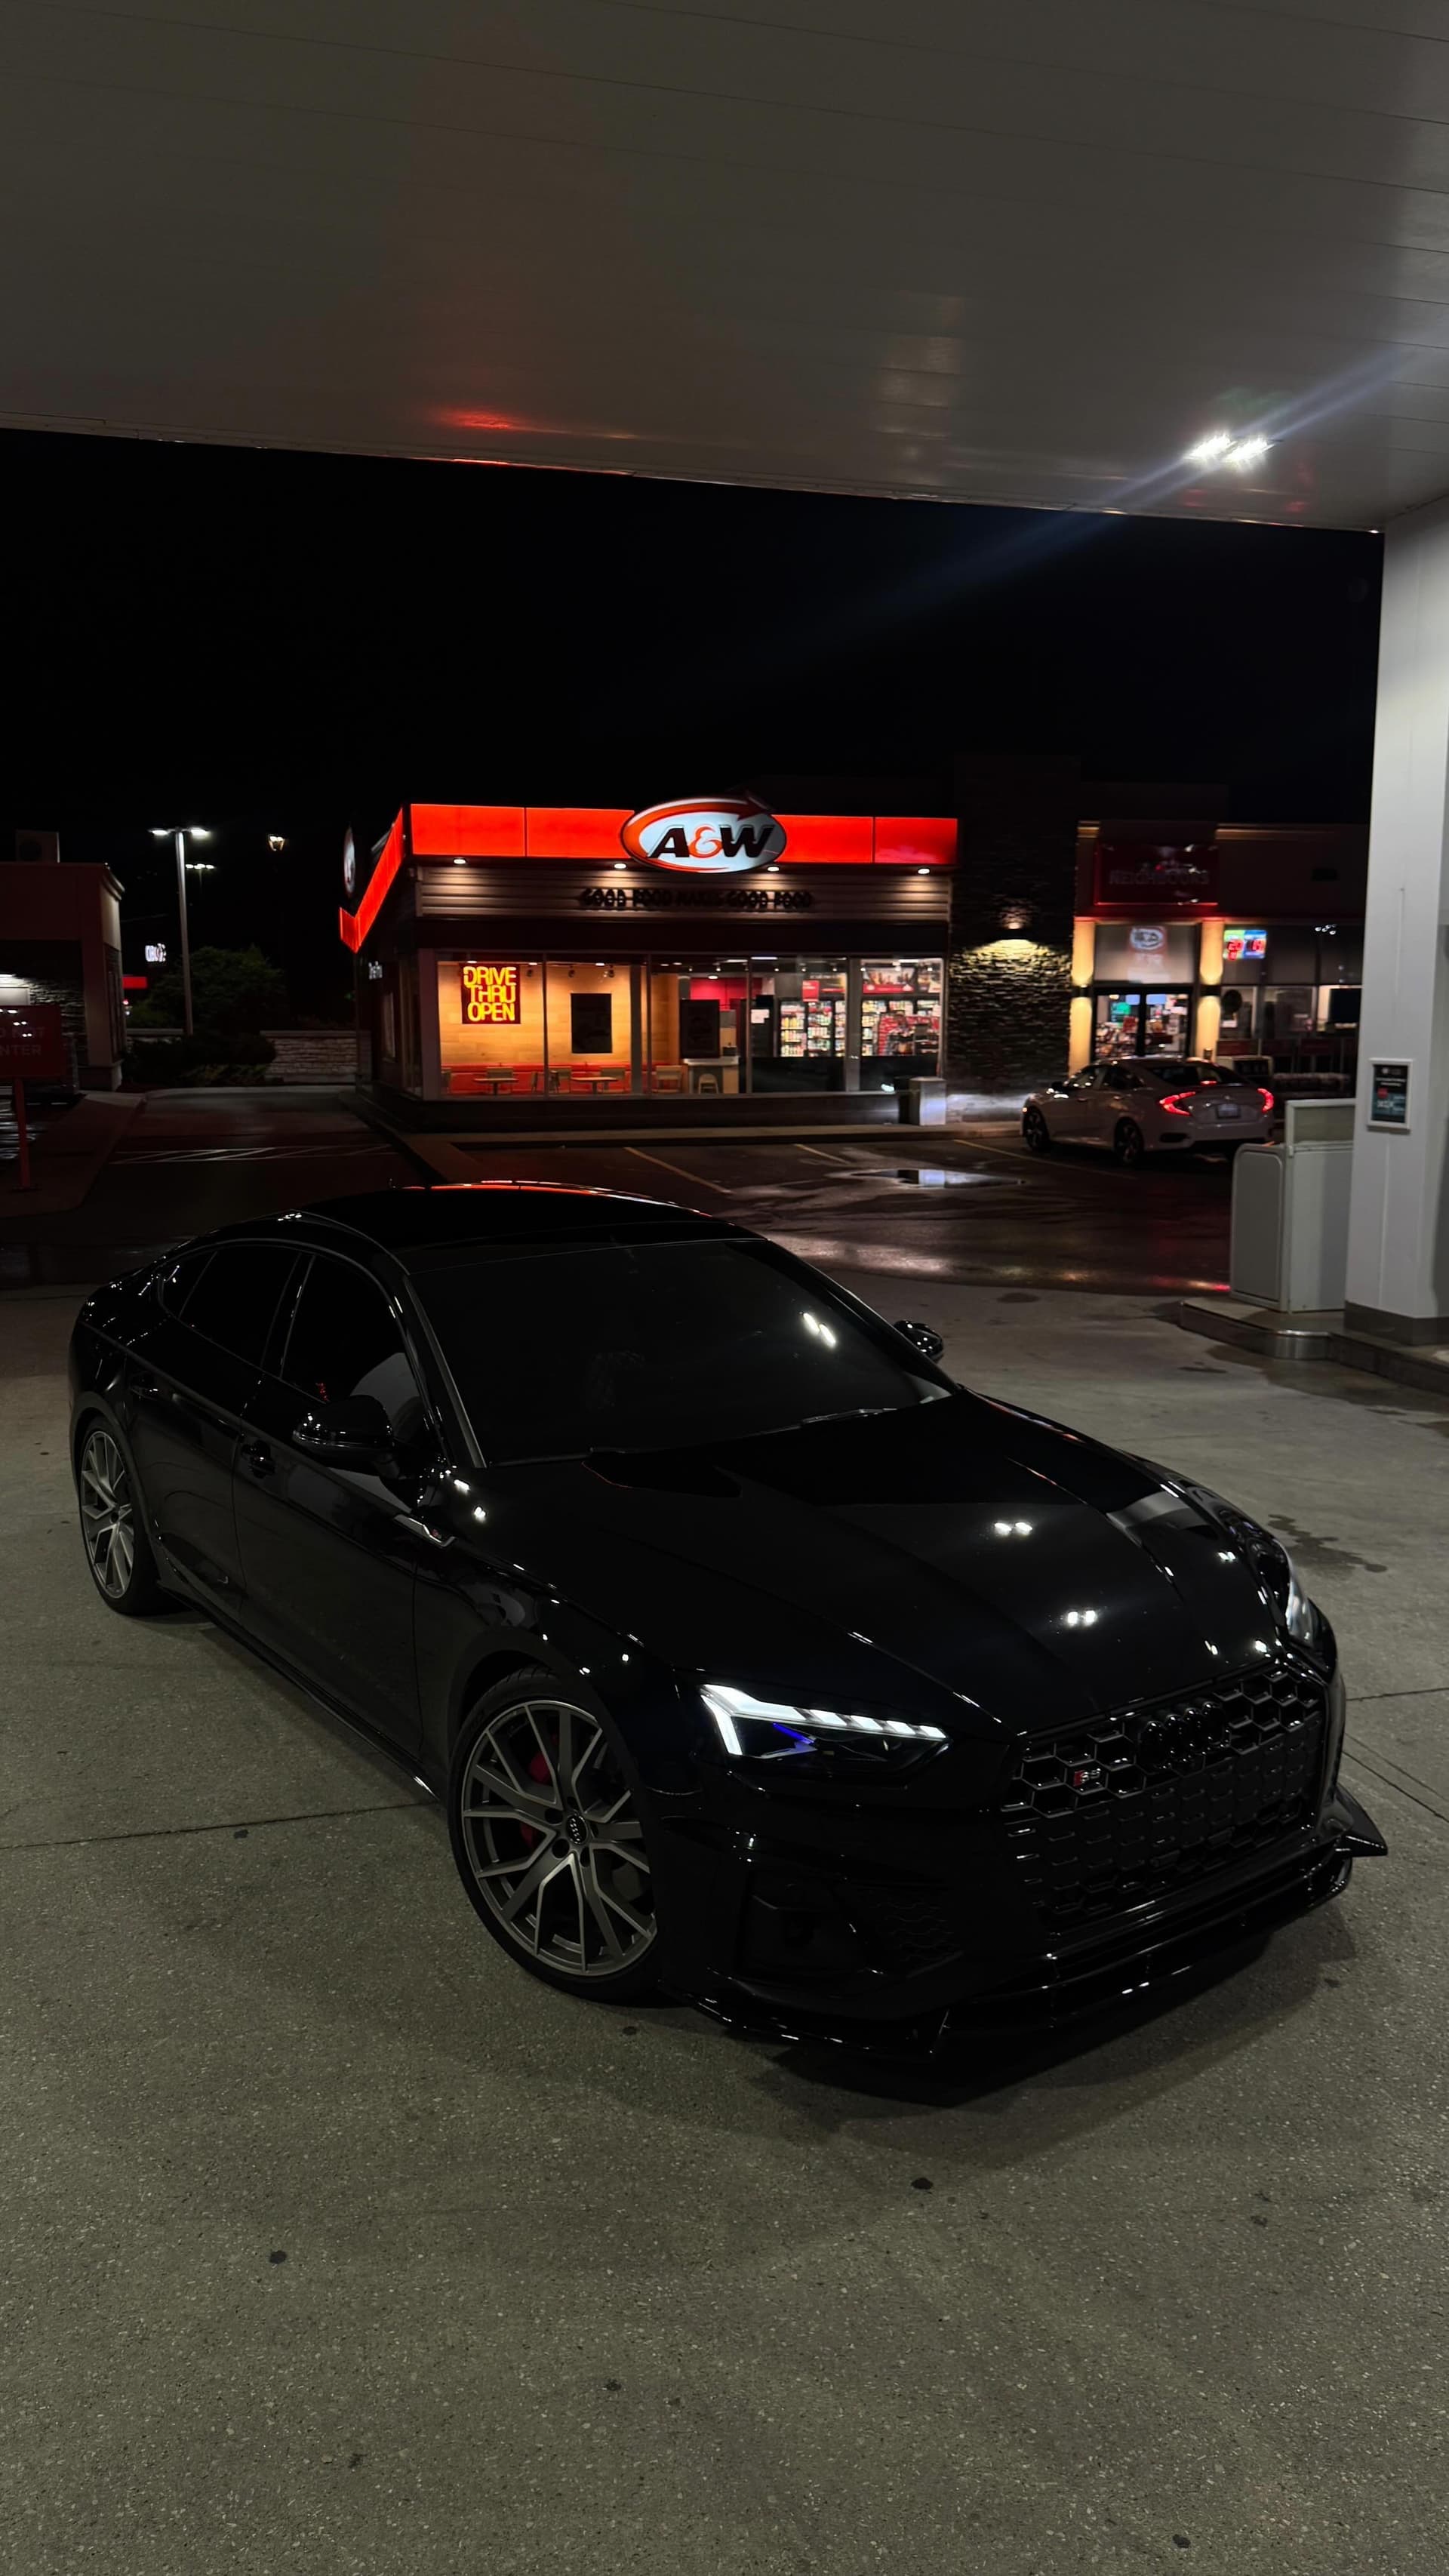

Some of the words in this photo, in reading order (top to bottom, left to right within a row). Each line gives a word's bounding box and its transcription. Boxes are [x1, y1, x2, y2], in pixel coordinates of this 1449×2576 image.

[647, 824, 775, 859] A&W
[580, 888, 626, 907] GOOD
[632, 888, 672, 907] FOOD
[726, 890, 768, 908] GOOD
[774, 891, 813, 908] FOOD
[463, 965, 517, 986] DRIVE
[466, 985, 516, 1003] THRU
[467, 1002, 516, 1022] OPEN
